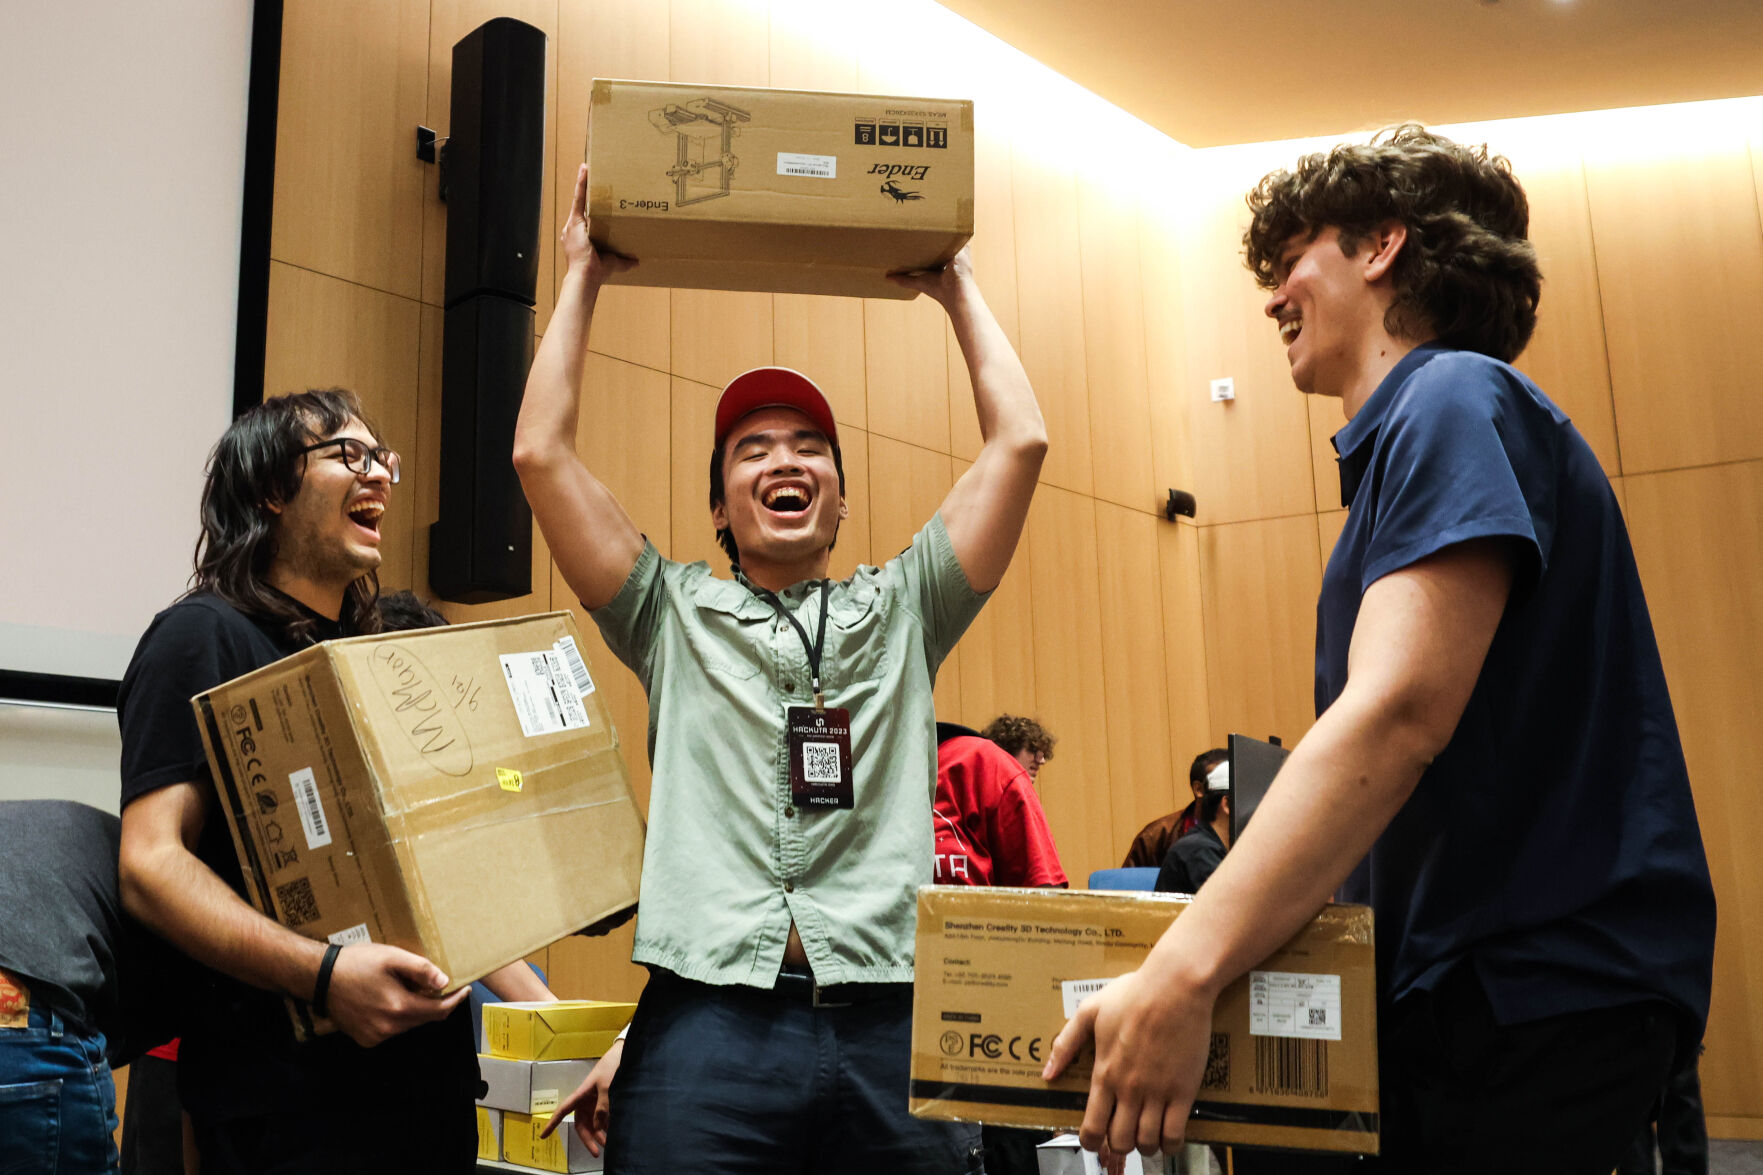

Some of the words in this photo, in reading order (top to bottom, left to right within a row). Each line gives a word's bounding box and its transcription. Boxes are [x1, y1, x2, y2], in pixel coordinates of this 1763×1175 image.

[867, 163, 931, 180] Ender
[619, 199, 669, 212] Ender-3
[792, 726, 828, 734] HACKUTA
[829, 727, 848, 735] 2023
[945, 921, 984, 931] Shenzhen
[986, 923, 1018, 934] Creality
[1035, 926, 1082, 937] Technology
